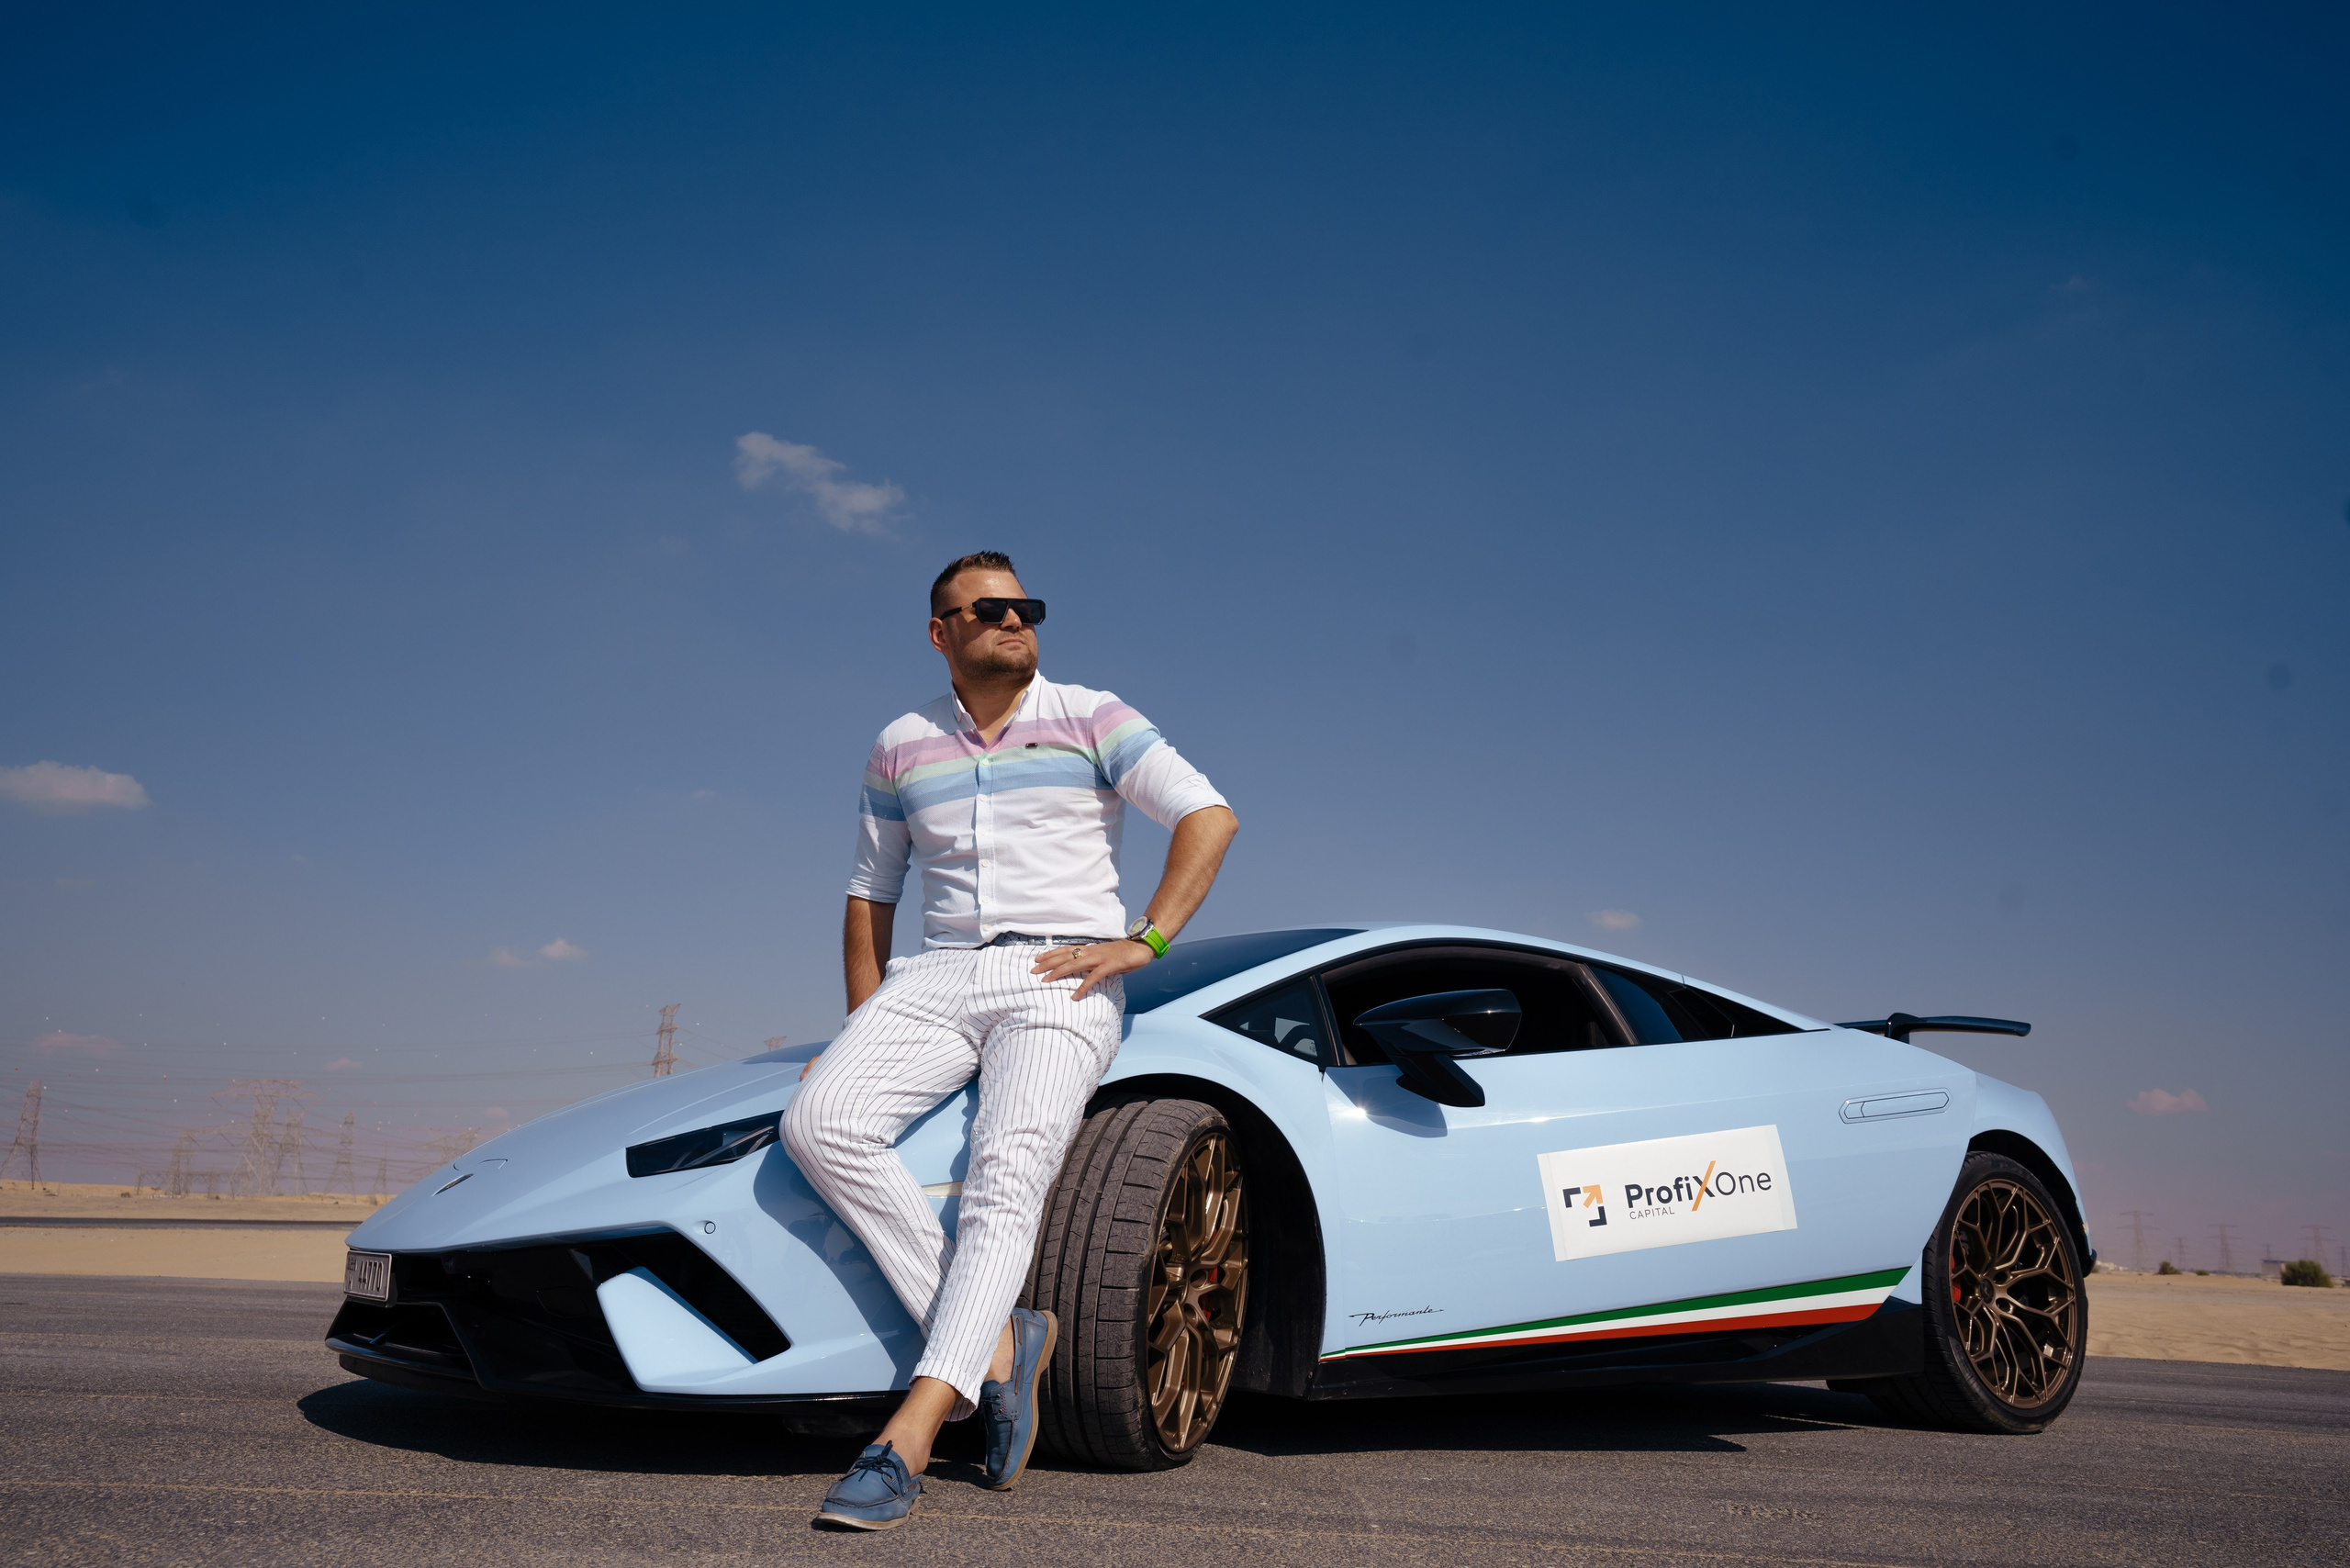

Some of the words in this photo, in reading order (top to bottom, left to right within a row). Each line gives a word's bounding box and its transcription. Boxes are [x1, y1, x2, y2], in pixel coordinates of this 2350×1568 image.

[1629, 1206, 1675, 1220] CAPITAL
[358, 1260, 384, 1292] 44770
[1348, 1305, 1444, 1327] Performante
